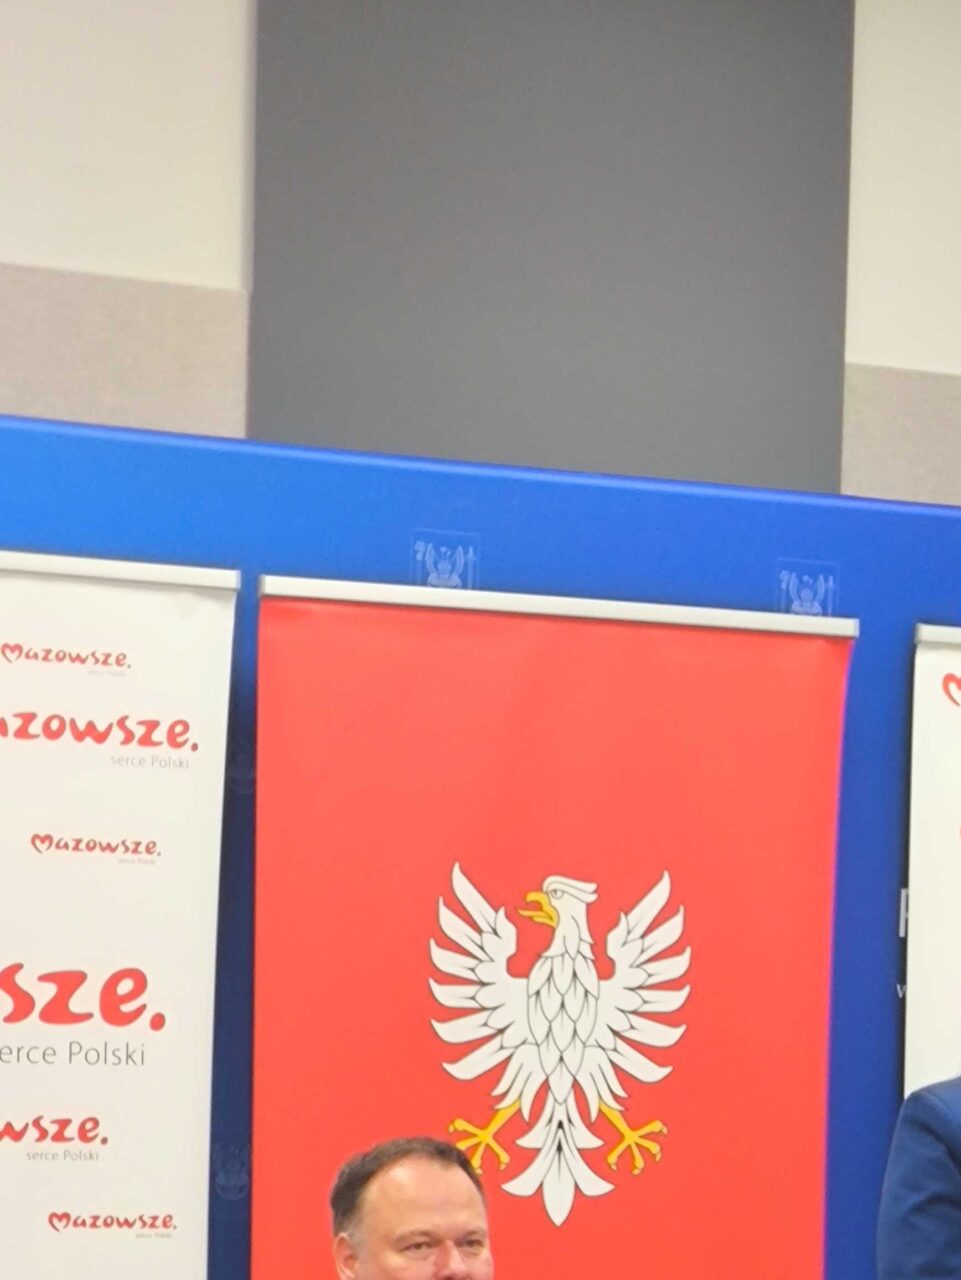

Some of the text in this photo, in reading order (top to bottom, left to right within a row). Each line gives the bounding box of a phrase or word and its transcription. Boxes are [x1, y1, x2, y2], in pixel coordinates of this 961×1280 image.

[111, 755, 189, 769] serce Polski
[68, 1041, 146, 1066] Polski
[26, 1149, 99, 1162] serce Polski
